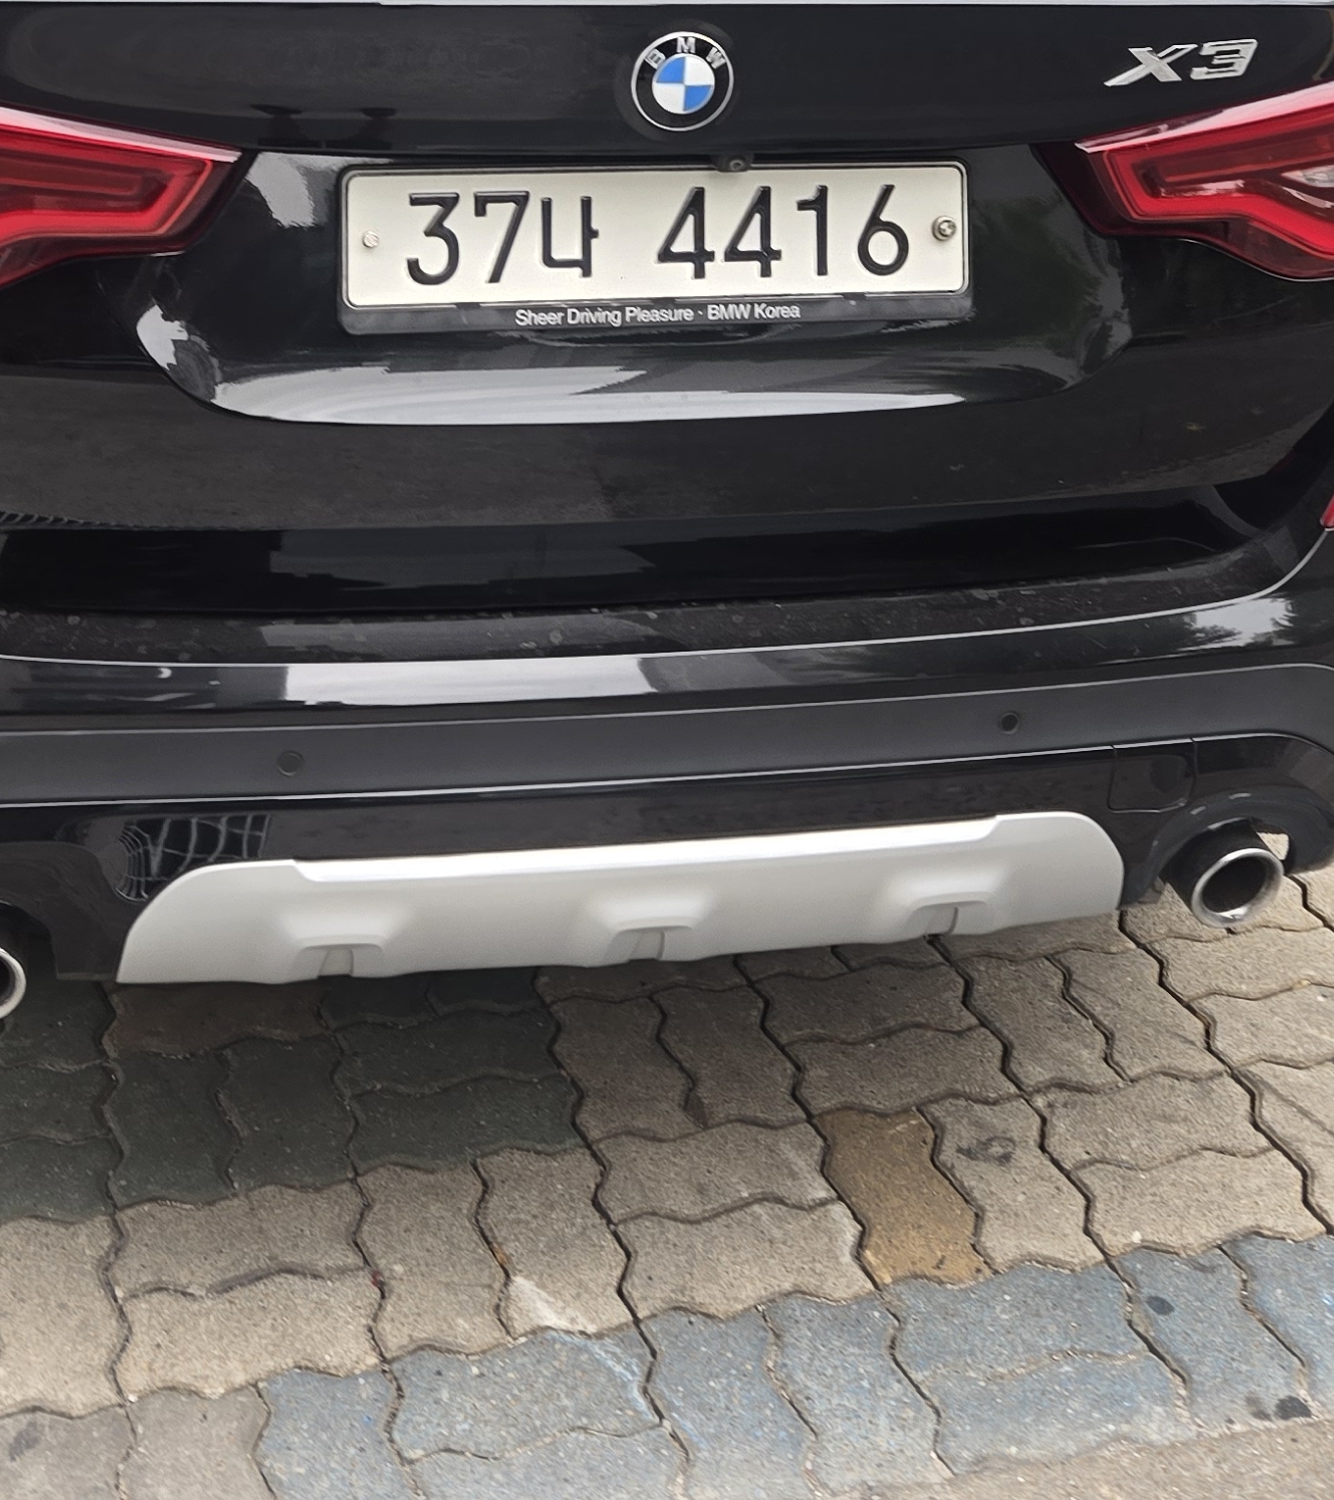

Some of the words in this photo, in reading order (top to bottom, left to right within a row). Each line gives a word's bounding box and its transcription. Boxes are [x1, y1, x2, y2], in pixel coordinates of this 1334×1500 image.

[644, 36, 726, 69] BMW
[1103, 38, 1258, 87] X3
[406, 191, 599, 285] 37나
[657, 184, 910, 280] 4416
[515, 309, 564, 326] Sheer
[567, 308, 622, 327] Driving
[625, 305, 694, 323] Pleasure
[707, 303, 751, 321] BMW
[753, 303, 801, 320] Korea
